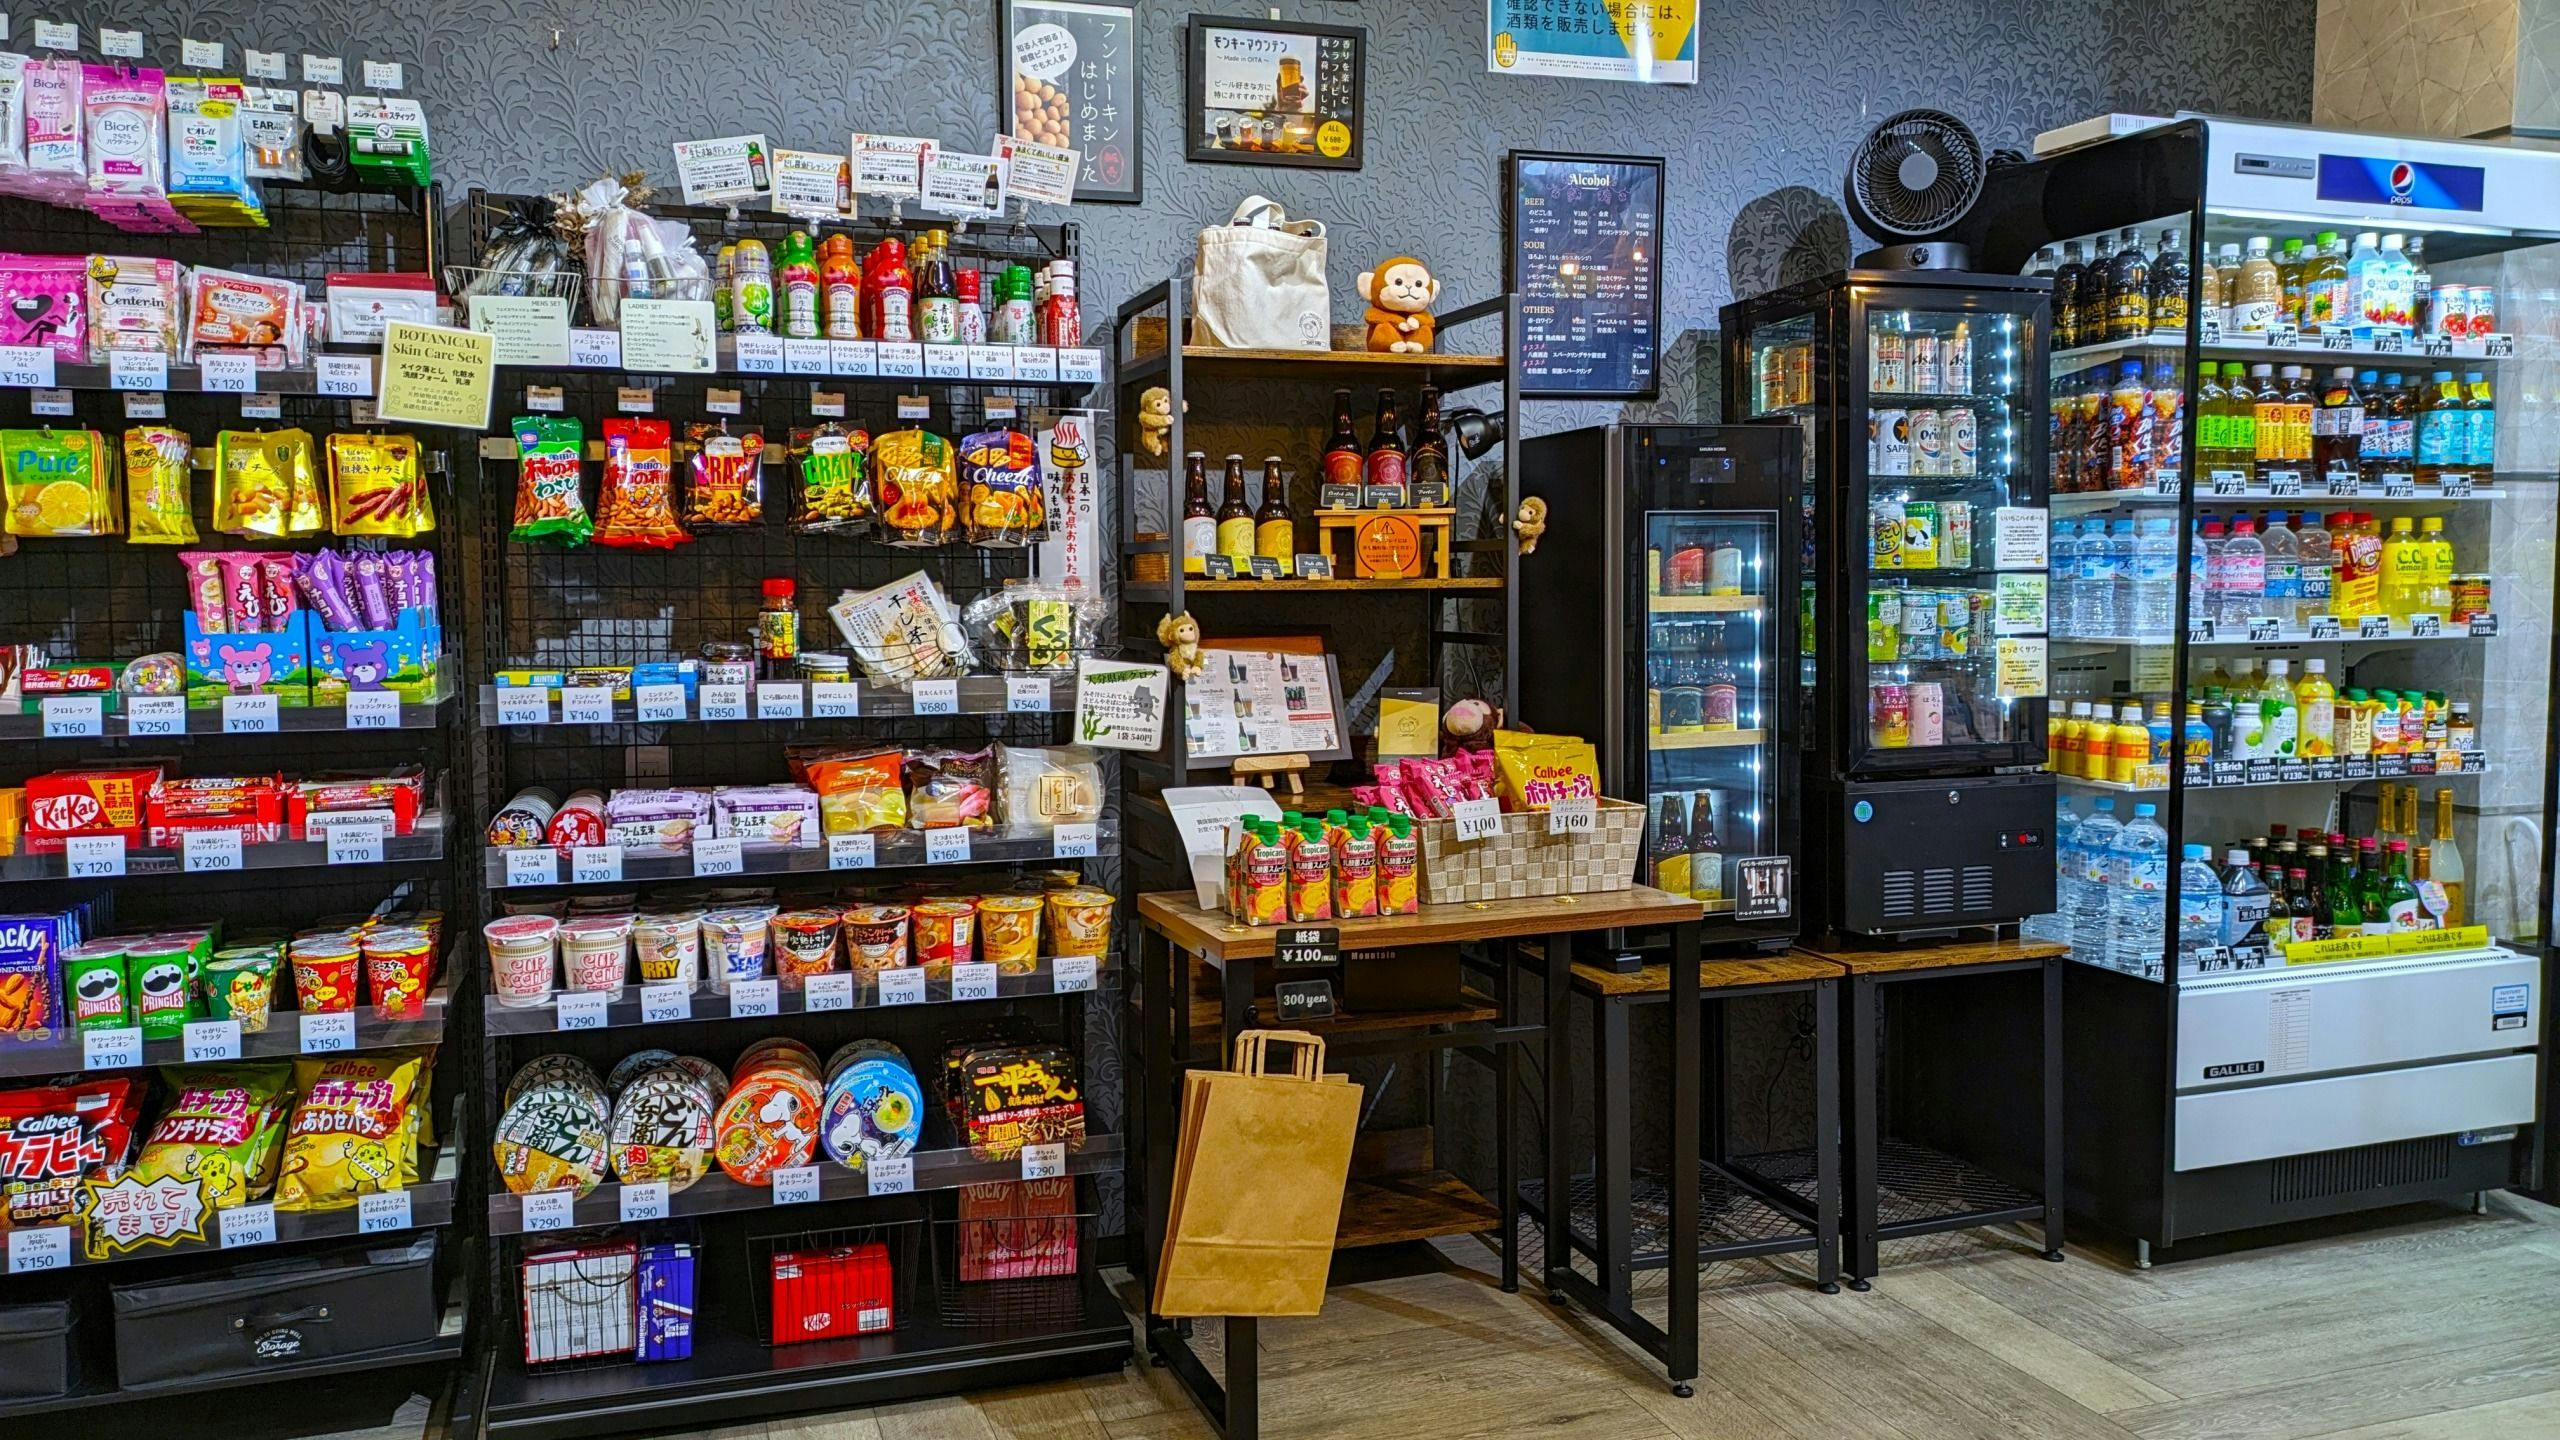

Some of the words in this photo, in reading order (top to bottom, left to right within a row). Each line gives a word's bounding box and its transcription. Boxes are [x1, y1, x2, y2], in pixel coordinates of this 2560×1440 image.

[1506, 13, 1665, 39] 酒類を販売しません。
[1016, 33, 1065, 51] 知る人ぞ知る!
[1214, 35, 1288, 53] モンキーマウンテン
[1019, 42, 1070, 65] 朝食ビュッフェ
[1031, 55, 1068, 72] でも大人気
[1319, 37, 1330, 115] 新入荷しました
[1341, 39, 1351, 105] 香りを楽しむ
[33, 78, 66, 90] Bioré
[1100, 21, 1120, 142] フンドーキン
[1330, 38, 1340, 120] クラフトビール
[1214, 80, 1272, 91] ビール好きな方に
[1214, 91, 1271, 102] 特におすすめです
[104, 120, 139, 131] Bioré
[252, 119, 274, 130] EAR
[1080, 60, 1098, 183] はじめました
[1328, 125, 1340, 133] ALL
[1568, 173, 1610, 187] Alcohol
[1524, 198, 1545, 206] BEER
[2390, 196, 2412, 206] pepsi
[1524, 241, 1545, 249] SOUR
[101, 291, 167, 308] Center-in
[1523, 306, 1555, 314] OTHERS
[399, 329, 480, 350] BOTANICAL
[392, 343, 423, 357] Skin
[424, 347, 456, 361] Care
[457, 352, 484, 365] Sets
[576, 354, 608, 364] ¥600
[744, 360, 774, 370] ¥370
[791, 362, 821, 371] ¥420
[838, 363, 867, 373] ¥420
[884, 364, 914, 375] ¥420
[931, 366, 960, 376] ¥420
[976, 367, 1004, 377] ¥320
[1019, 368, 1048, 379] ¥320
[1065, 370, 1092, 380] ¥320
[210, 378, 244, 390] ¥120
[325, 382, 357, 393] ¥180
[17, 450, 78, 473] Puré
[973, 465, 1032, 484] Cheeza
[1080, 472, 1091, 513] 日本一の
[1047, 471, 1062, 533] 味力も満載
[1064, 471, 1078, 575] おんせん県おおいた
[2000, 515, 2044, 523] いいちこハイボール
[2303, 582, 2325, 592] 600
[239, 581, 259, 618] えび
[2000, 644, 2042, 655] はっさくサワー
[534, 674, 558, 684] MINTIA
[819, 705, 846, 715] ¥370
[921, 702, 948, 713] ¥680
[1013, 700, 1040, 710] ¥540
[505, 711, 536, 721] ¥140
[569, 711, 599, 721] ¥140
[644, 708, 674, 718] ¥140
[706, 707, 735, 718] ¥850
[763, 706, 792, 717] ¥440
[51, 723, 86, 734] ¥160
[136, 722, 170, 732] ¥250
[231, 719, 264, 730] ¥100
[1533, 766, 1573, 779] Calbee
[2214, 762, 2243, 772] 生茶rich
[2463, 762, 2479, 772] 350
[2283, 772, 2302, 780] ¥130
[2318, 771, 2332, 779] ¥90
[103, 783, 132, 795] 史上
[103, 796, 133, 809] 最高
[43, 795, 95, 829] KitKat
[1463, 816, 1496, 834] ¥100
[1555, 813, 1588, 828] ¥160
[335, 849, 369, 861] ¥170
[932, 850, 959, 860] ¥160
[1060, 845, 1085, 856] ¥160
[192, 855, 230, 868] ¥200
[701, 861, 732, 872] ¥200
[836, 857, 863, 867] ¥160
[74, 862, 113, 874] ¥120
[515, 873, 545, 883] ¥240
[580, 870, 611, 880] ¥200
[1295, 931, 1320, 943] 紙袋
[2415, 931, 2464, 944] これはお酒です
[2314, 940, 2363, 953] これはお酒です
[581, 952, 619, 969] CUP
[1282, 949, 1321, 962] ¥100
[509, 955, 546, 973] CUP
[2204, 960, 2222, 971] 180
[2240, 958, 2258, 969] 270
[501, 970, 552, 988] NOODLE
[573, 966, 624, 983] NOODLE
[1059, 979, 1088, 990] ¥200
[647, 990, 682, 998] カップヌードル
[886, 991, 914, 1003] ¥210
[957, 987, 987, 998] ¥200
[142, 989, 184, 1013] PRINGLES
[561, 1002, 601, 1010] カップヌードル
[812, 997, 842, 1008] ¥210
[1283, 993, 1304, 1005] 300
[1307, 993, 1327, 1008] yen
[78, 995, 121, 1018] PRINGLES
[737, 1004, 767, 1014] ¥290
[650, 1008, 679, 1020] ¥290
[565, 1017, 596, 1027] ¥290
[195, 1027, 228, 1035] じゃがりこ
[308, 1039, 340, 1050] ¥150
[192, 1047, 226, 1058] ¥190
[91, 1054, 127, 1066] ¥170
[2209, 1062, 2260, 1078] GALILEI
[974, 1060, 1078, 1101] 一平ちゃん
[18, 1115, 79, 1132] Calbee
[1027, 1166, 1054, 1177] ¥290
[874, 1180, 903, 1192] ¥290
[103, 1188, 187, 1214] 売れて
[779, 1190, 809, 1203] ¥290
[528, 1204, 563, 1213] きつねうどん
[627, 1206, 658, 1218] ¥290
[225, 1210, 269, 1222] ポテトチップス
[118, 1208, 190, 1238] ます!
[225, 1217, 269, 1228] フレンチサラダ
[366, 1217, 398, 1229] ¥160
[529, 1217, 561, 1229] ¥290
[227, 1231, 262, 1244] ¥190
[17, 1256, 54, 1268] ¥150
[256, 1340, 300, 1353] Storage
